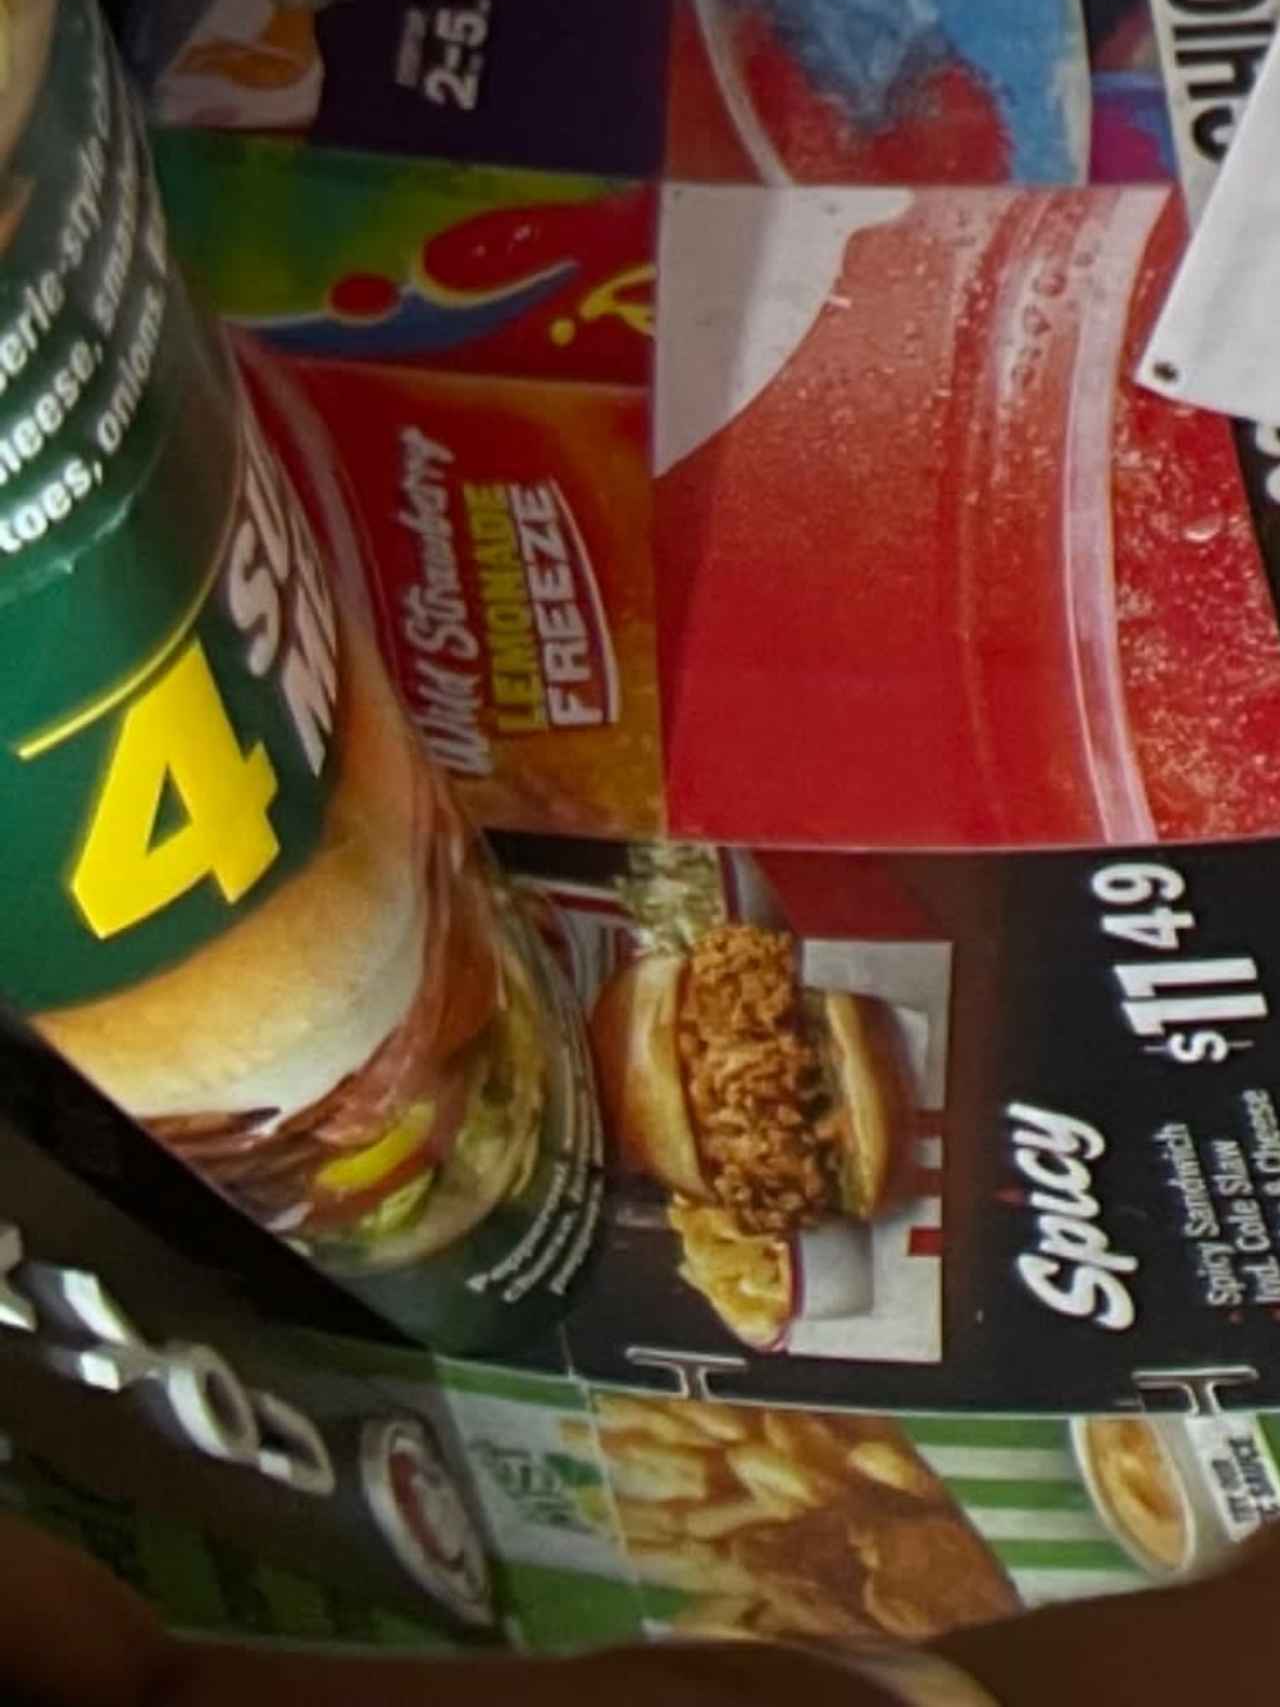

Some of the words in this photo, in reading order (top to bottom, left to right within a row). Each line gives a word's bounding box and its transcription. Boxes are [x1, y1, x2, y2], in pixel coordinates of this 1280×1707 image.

[397, 428, 478, 658] Strawberry
[462, 481, 548, 733] LEMONADE
[510, 481, 608, 728] FREEZE
[415, 662, 492, 778] Wild
[70, 640, 282, 940] 4
[1155, 1124, 1220, 1237] Sandwich
[1213, 1140, 1252, 1195] Slaw
[1198, 1240, 1244, 1304] Spicy
[1230, 1202, 1269, 1251] Cole
